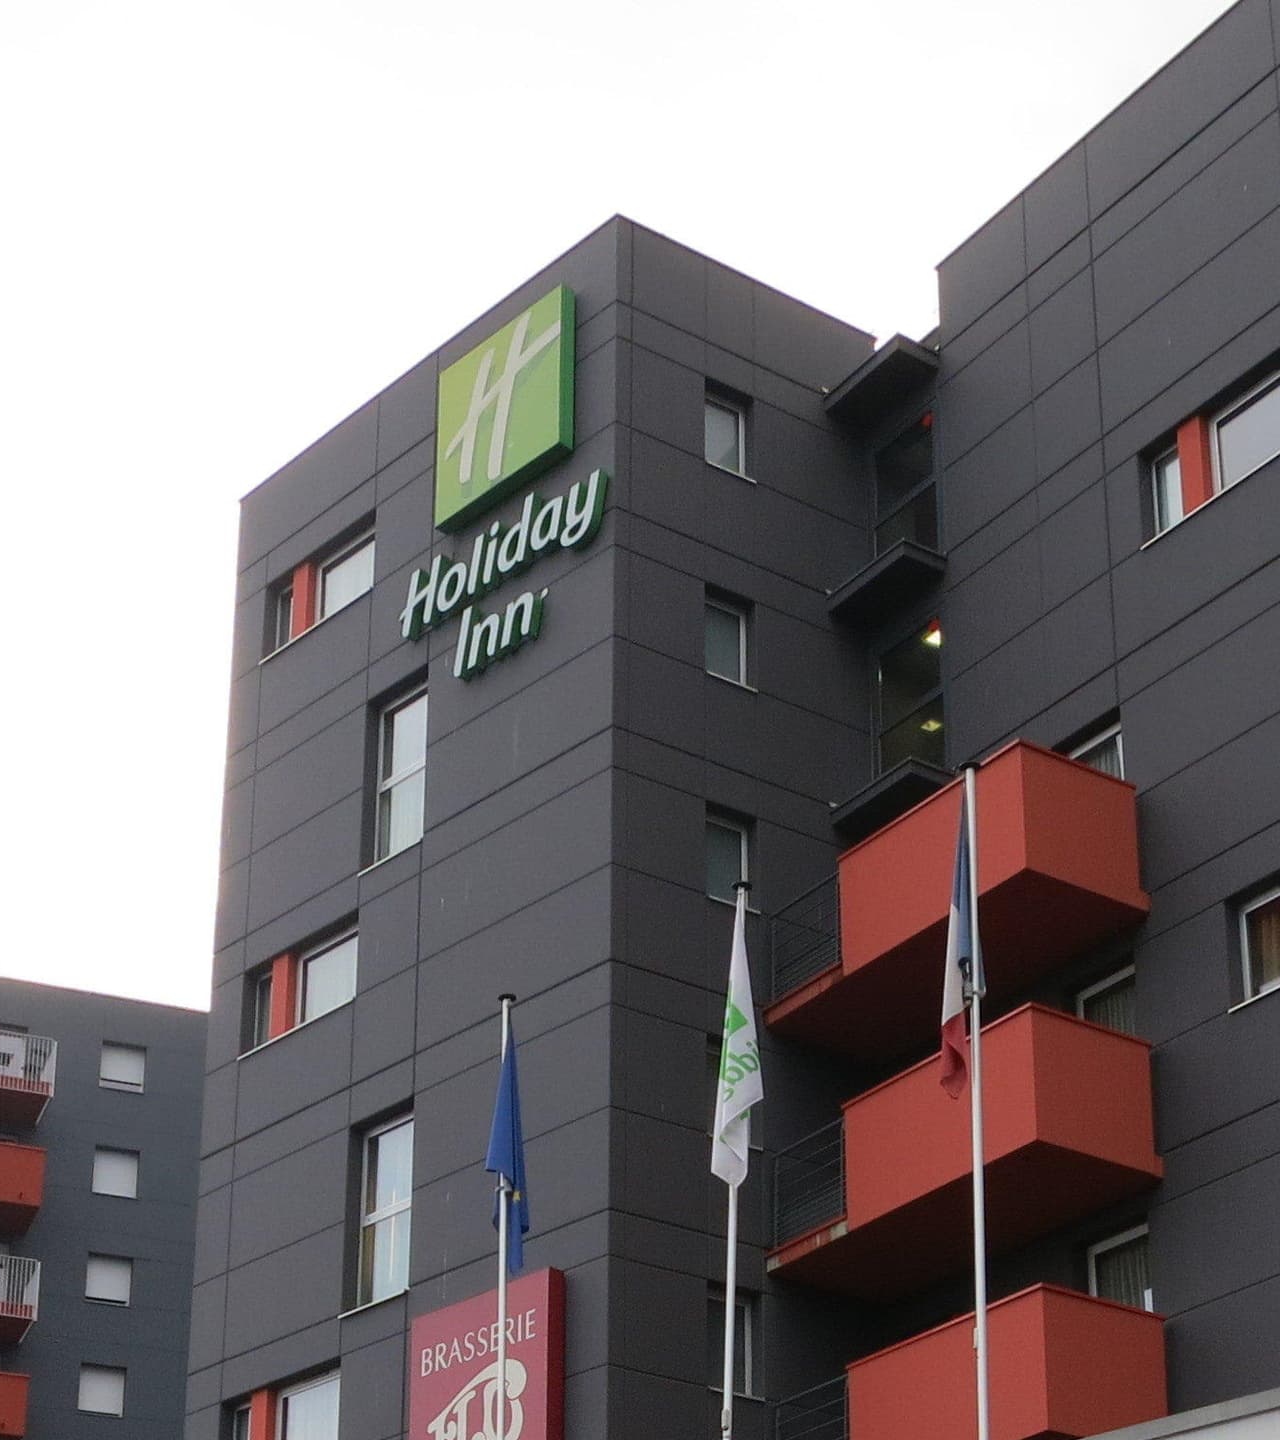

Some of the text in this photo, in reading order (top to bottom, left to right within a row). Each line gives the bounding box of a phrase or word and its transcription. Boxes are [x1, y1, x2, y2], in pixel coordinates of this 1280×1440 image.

[400, 469, 607, 640] Holiday
[453, 588, 549, 680] Inn
[421, 1308, 537, 1378] BRASSERIE
